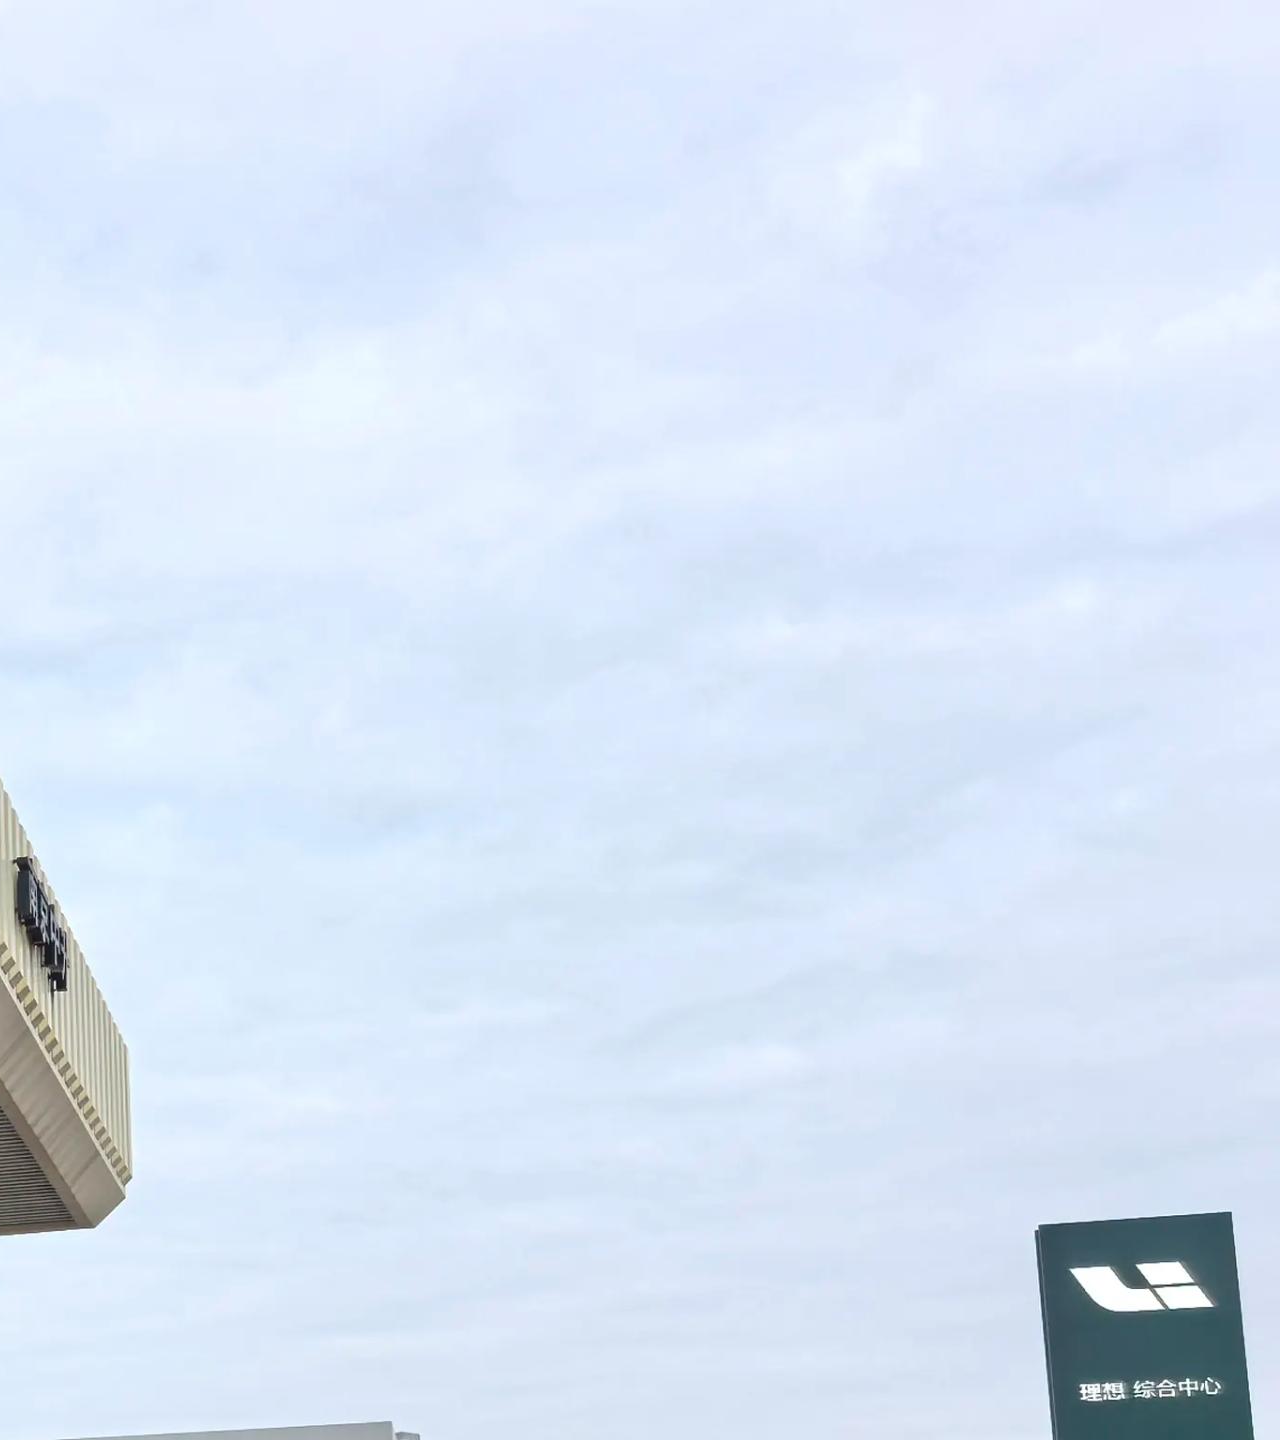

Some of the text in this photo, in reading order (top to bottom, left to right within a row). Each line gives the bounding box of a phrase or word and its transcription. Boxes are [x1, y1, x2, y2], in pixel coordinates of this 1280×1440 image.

[1079, 1376, 1222, 1402] 理想 综合中心
